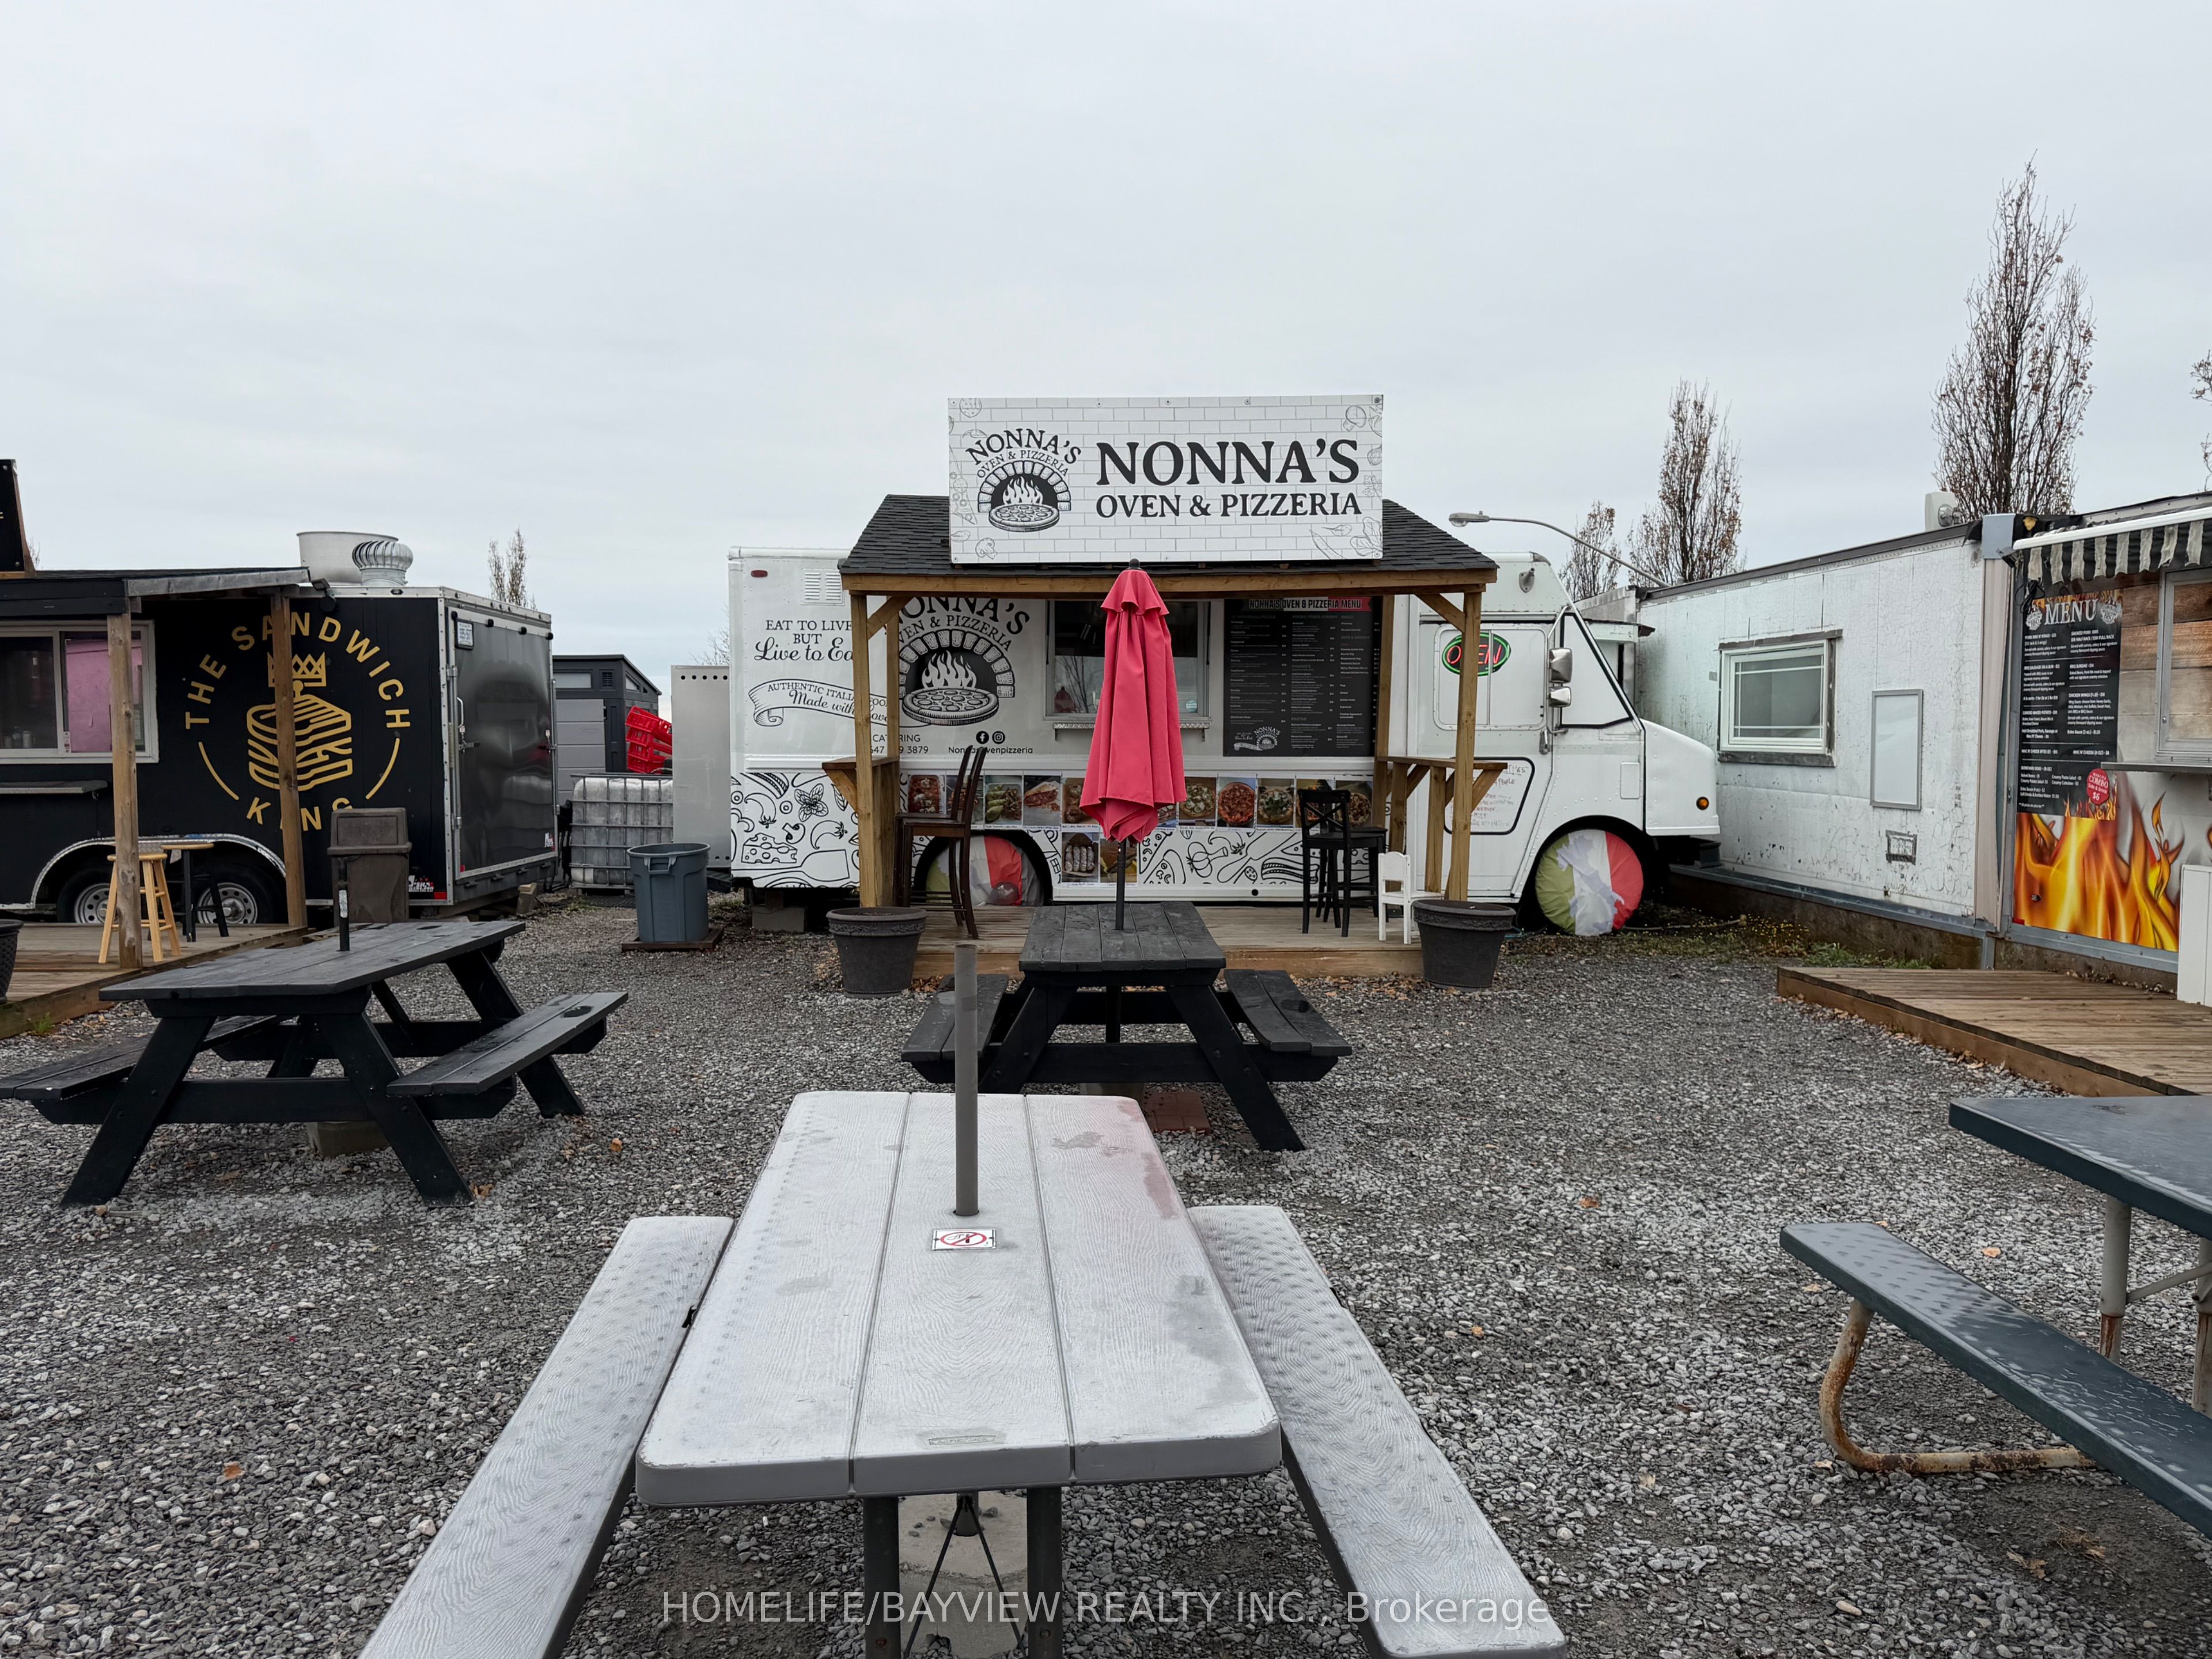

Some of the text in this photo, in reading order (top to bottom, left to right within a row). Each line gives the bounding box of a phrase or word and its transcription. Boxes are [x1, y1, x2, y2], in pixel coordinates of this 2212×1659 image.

[965, 428, 1082, 465] NONNA'S
[978, 450, 1069, 478] OVEN & PIZZERIA
[1096, 438, 1359, 486] NONNA'S
[1096, 493, 1362, 518] OVEN & PIZZERIA
[884, 596, 1030, 635] ONNA'S
[1249, 599, 1363, 609] NONNA'S OVEN & PIZZERIA MENU
[2044, 599, 2099, 625] MENU
[766, 620, 793, 631] EAT
[797, 620, 817, 631] TO
[899, 615, 1012, 652] VEN & PIZZERIA
[754, 636, 854, 661] Live to Ea
[793, 633, 822, 645] BUT
[1446, 645, 1503, 664] OEN
[185, 654, 227, 730] THE
[767, 682, 824, 695] AUTHENTIC
[789, 690, 828, 709] Made
[907, 745, 929, 754] 3879
[2089, 775, 2109, 789] COMBO
[2093, 791, 2100, 801] $6
[246, 797, 353, 832] KNG
